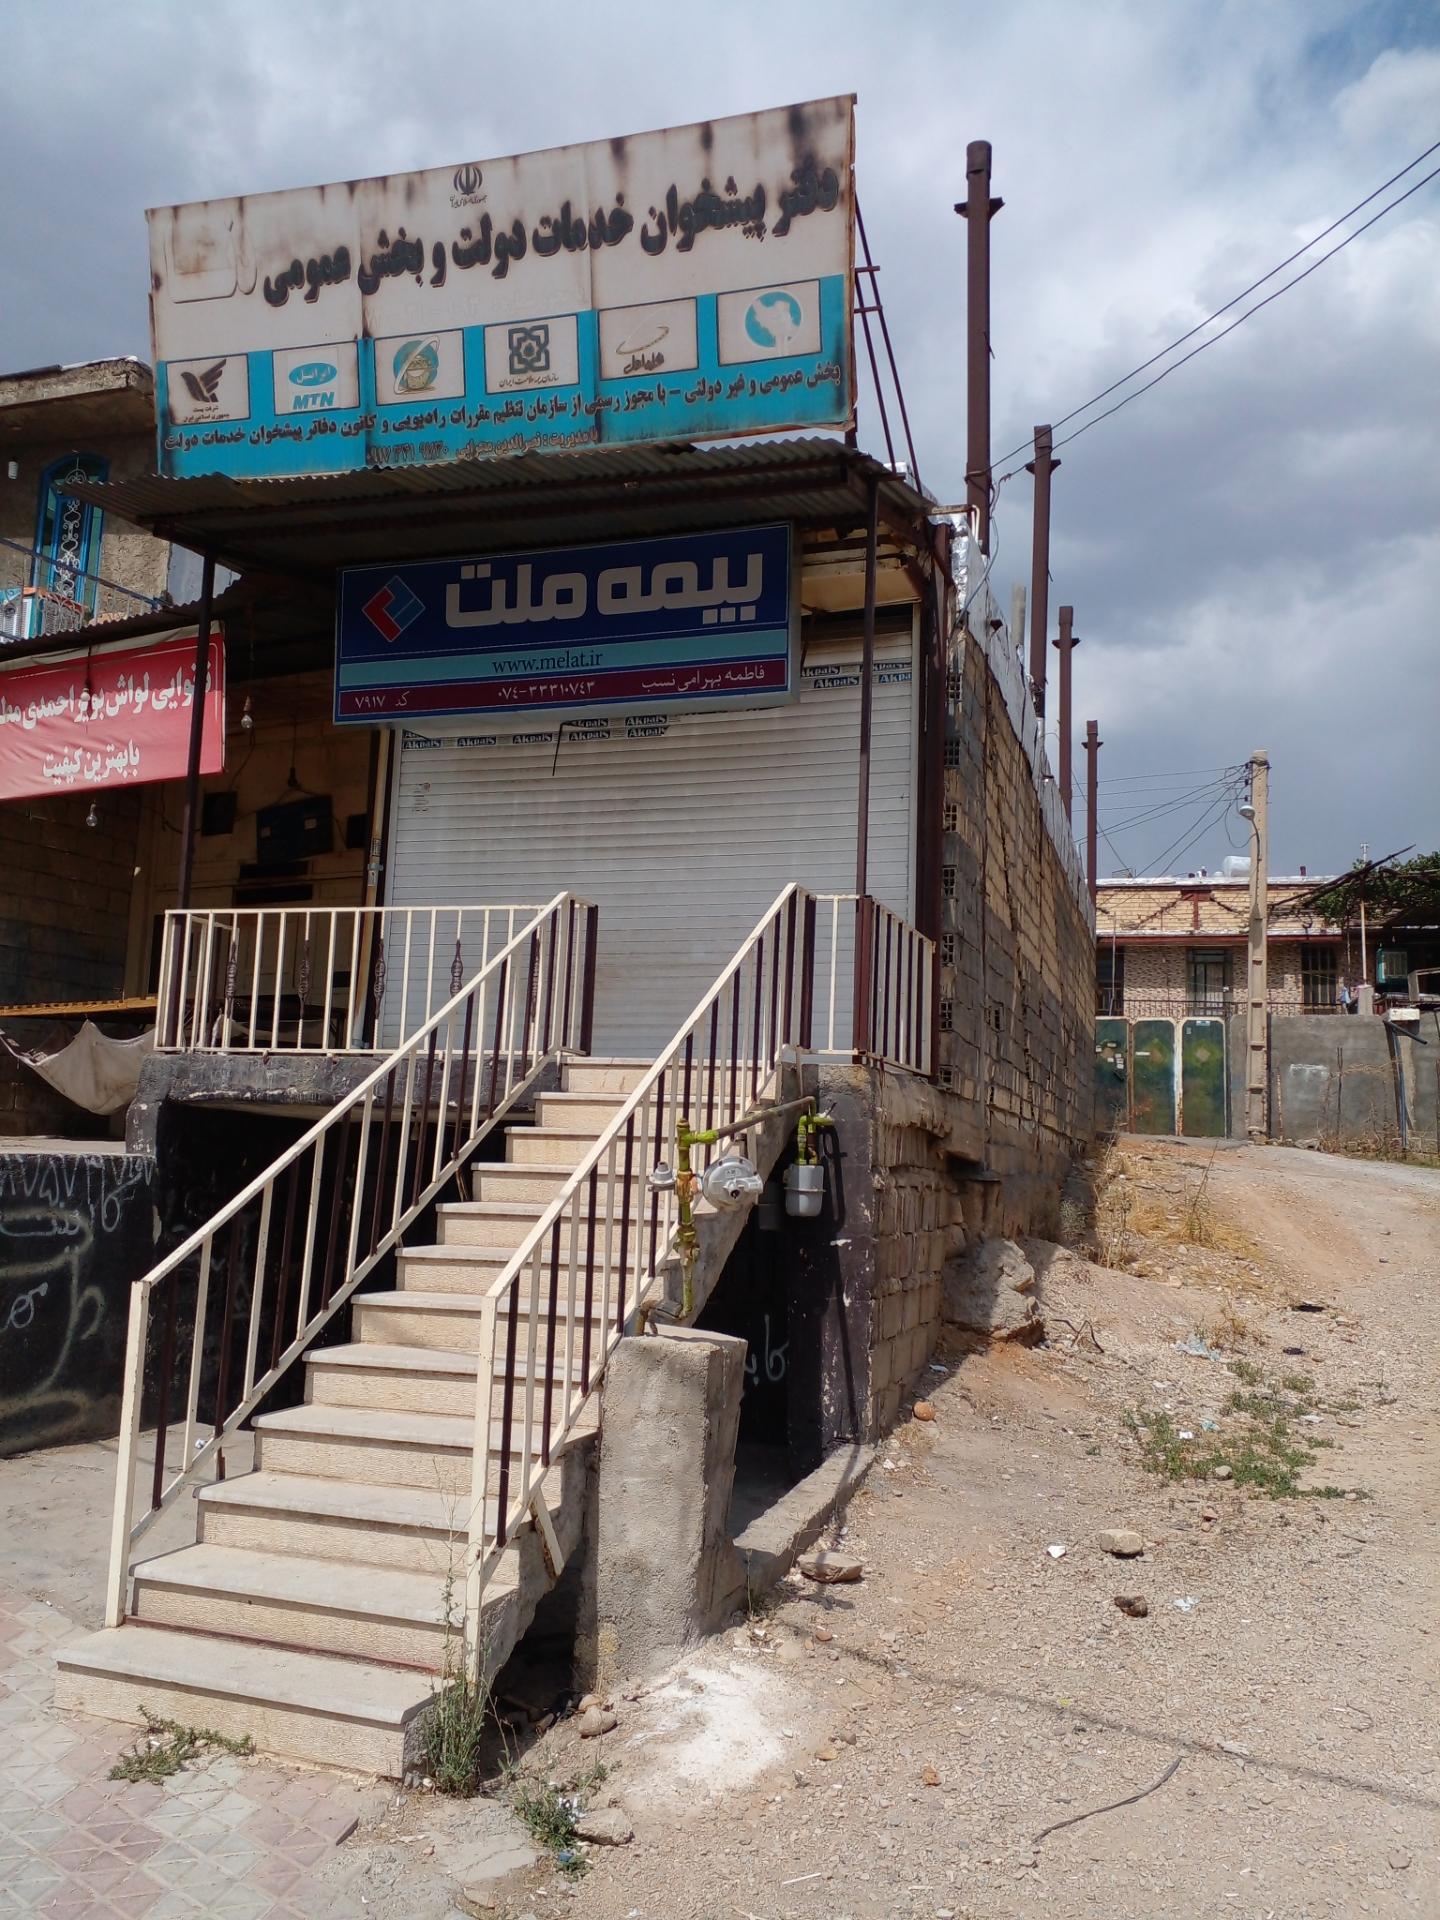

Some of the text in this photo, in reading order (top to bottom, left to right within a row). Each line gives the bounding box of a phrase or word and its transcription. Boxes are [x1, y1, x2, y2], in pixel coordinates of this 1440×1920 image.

[263, 160, 839, 307] دفتر پیشخوان خدمات دولت و بخش عمومی
[727, 374, 746, 399] غیر
[760, 369, 803, 394] عمومی
[807, 361, 841, 388] بخش
[292, 391, 335, 410] MTN
[623, 387, 654, 412] مجوز
[657, 383, 666, 406] با
[685, 378, 722, 404] دولتی
[749, 380, 757, 396] و
[451, 403, 490, 430] مقررات
[494, 399, 524, 424] تنظیم
[527, 395, 568, 421] سازمان
[571, 392, 581, 417] از
[305, 417, 337, 442] دفاتر
[341, 412, 378, 438] کانون
[381, 418, 389, 433] و
[393, 407, 446, 433] رادیویی
[165, 430, 199, 451] دولت
[202, 428, 246, 446] خدمات
[250, 421, 303, 445] پیشخوان
[446, 553, 763, 628] بیمه ملت
[493, 649, 603, 673] www.melat.ir
[152, 660, 212, 711] ننوایی
[642, 664, 766, 693] فاطمه بهرامی نسب
[105, 671, 150, 717] لواش
[23, 684, 75, 730] احمدی
[42, 746, 83, 785] کیفیت
[84, 743, 128, 783] بهترین
